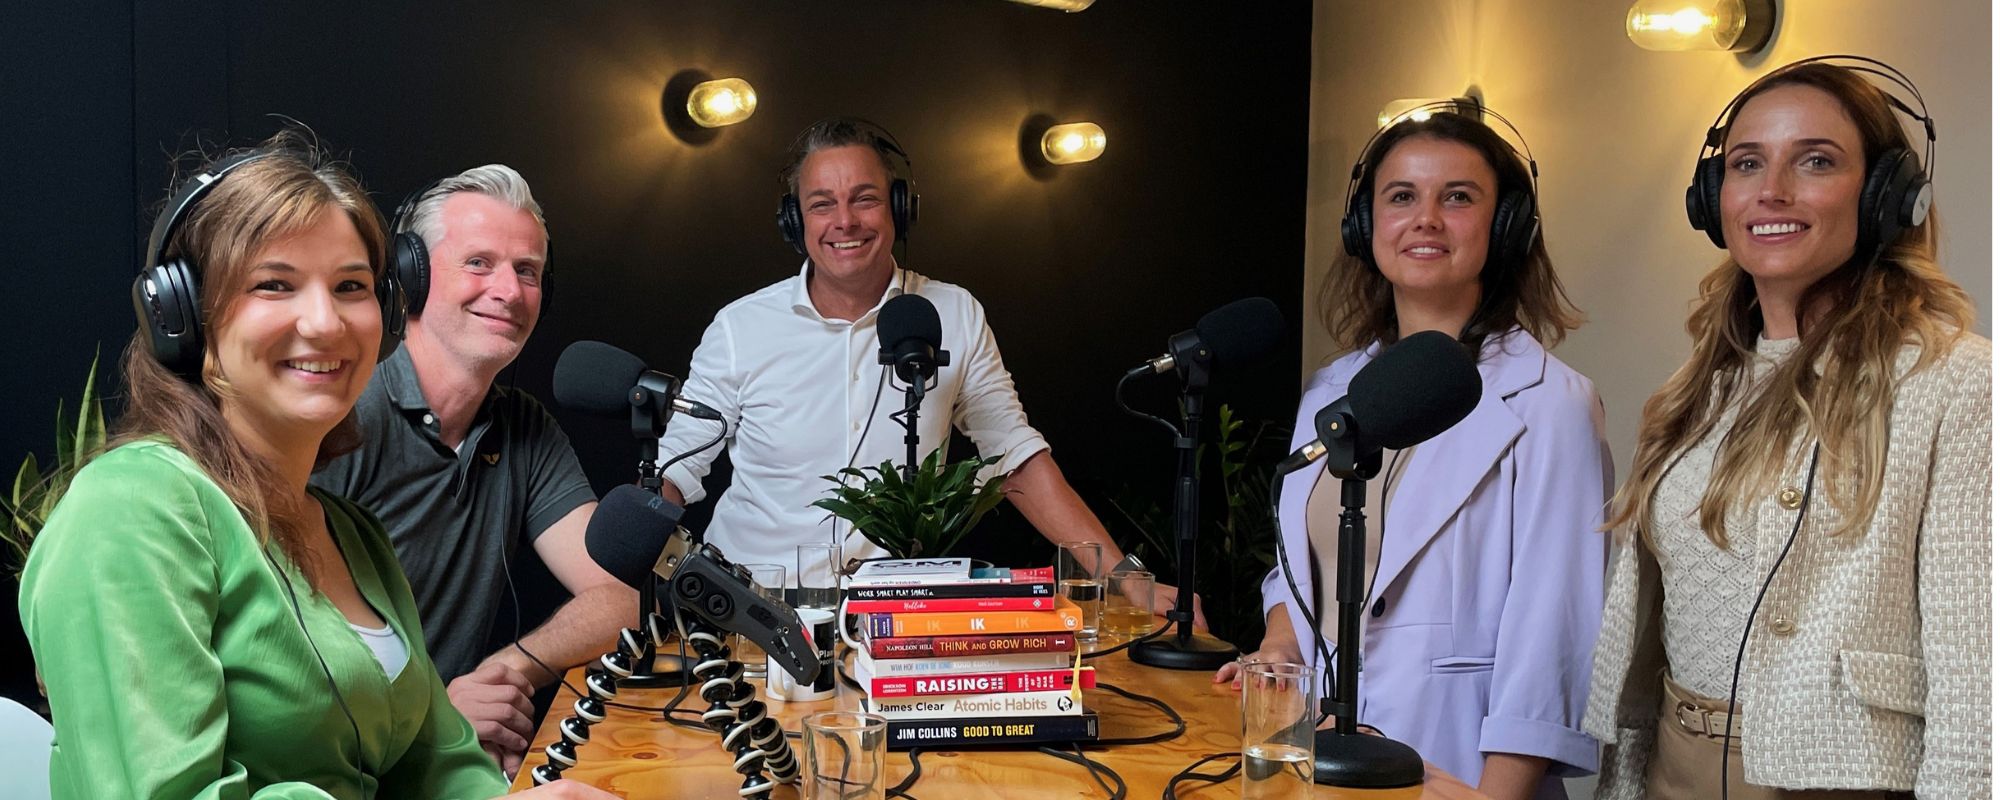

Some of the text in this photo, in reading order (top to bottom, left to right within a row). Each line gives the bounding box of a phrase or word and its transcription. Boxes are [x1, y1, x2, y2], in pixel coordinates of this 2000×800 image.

[928, 617, 1029, 631] IK IK IK
[940, 641, 969, 651] THINK
[989, 639, 1020, 649] GROW
[1024, 638, 1046, 648] RICH
[916, 678, 988, 693] RAISING
[878, 702, 945, 712] James Clear
[954, 698, 1047, 712] Atomic Habits
[896, 727, 957, 740] JIM COLLINS
[963, 724, 1034, 737] GOOD TO GREAT
